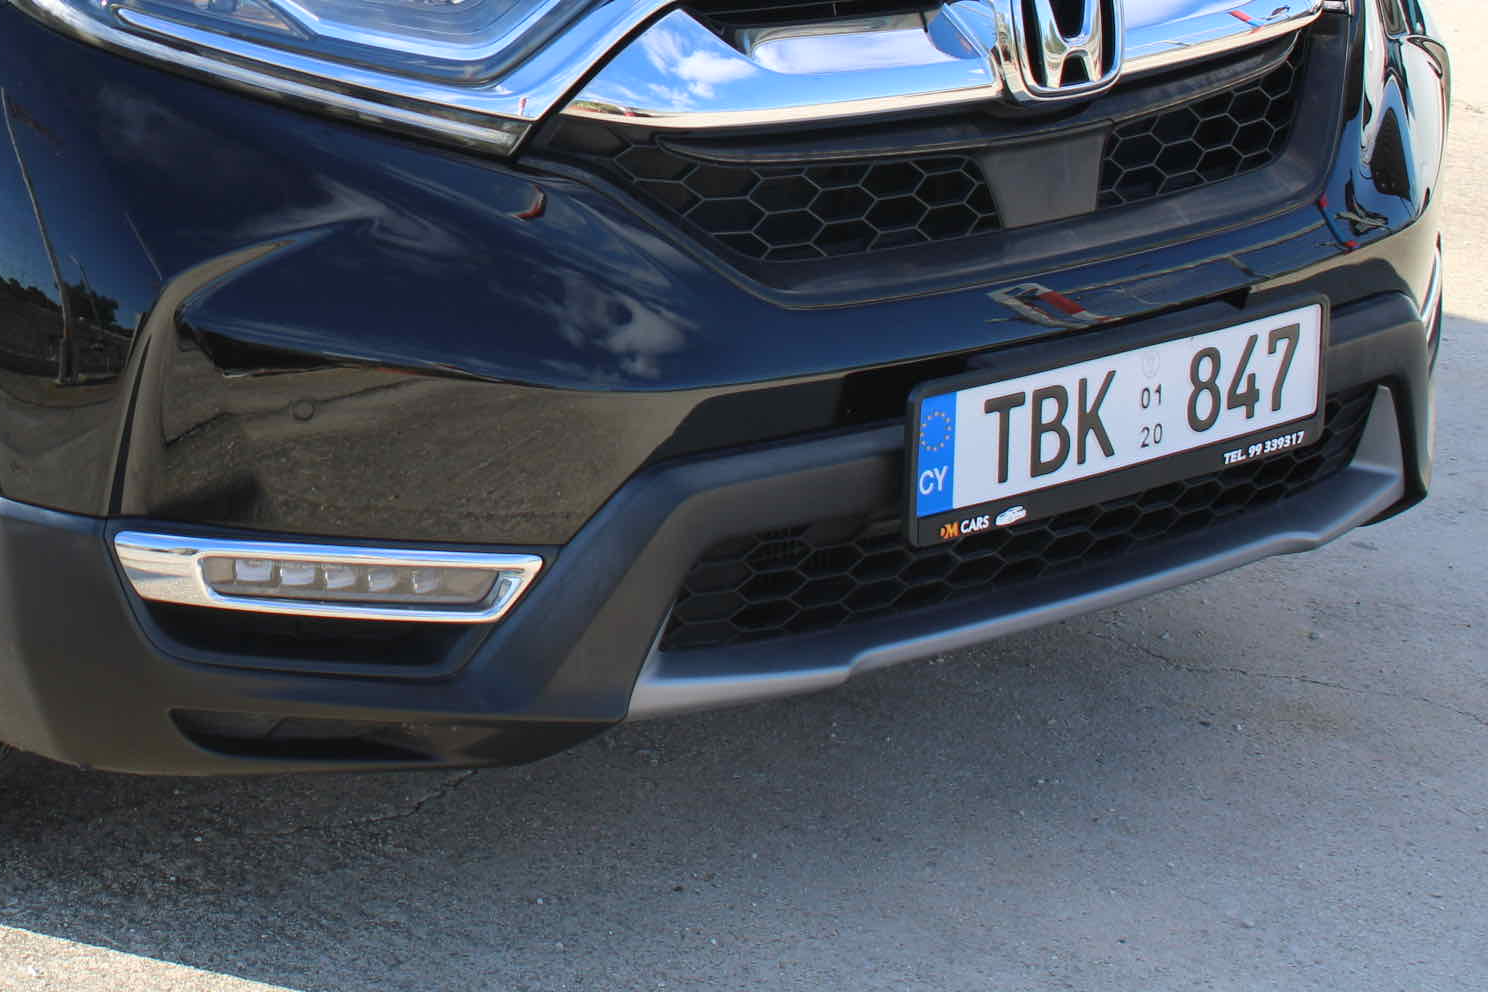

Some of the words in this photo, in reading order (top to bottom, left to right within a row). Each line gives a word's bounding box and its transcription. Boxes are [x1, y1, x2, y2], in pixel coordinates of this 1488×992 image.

[984, 369, 1117, 484] TBK
[1186, 322, 1301, 433] 847
[1141, 384, 1162, 409] 01
[1140, 423, 1163, 448] 20
[1248, 442, 1263, 458] 99
[1264, 430, 1306, 453] 339317
[919, 465, 949, 496] CY
[960, 515, 991, 535] CARS
